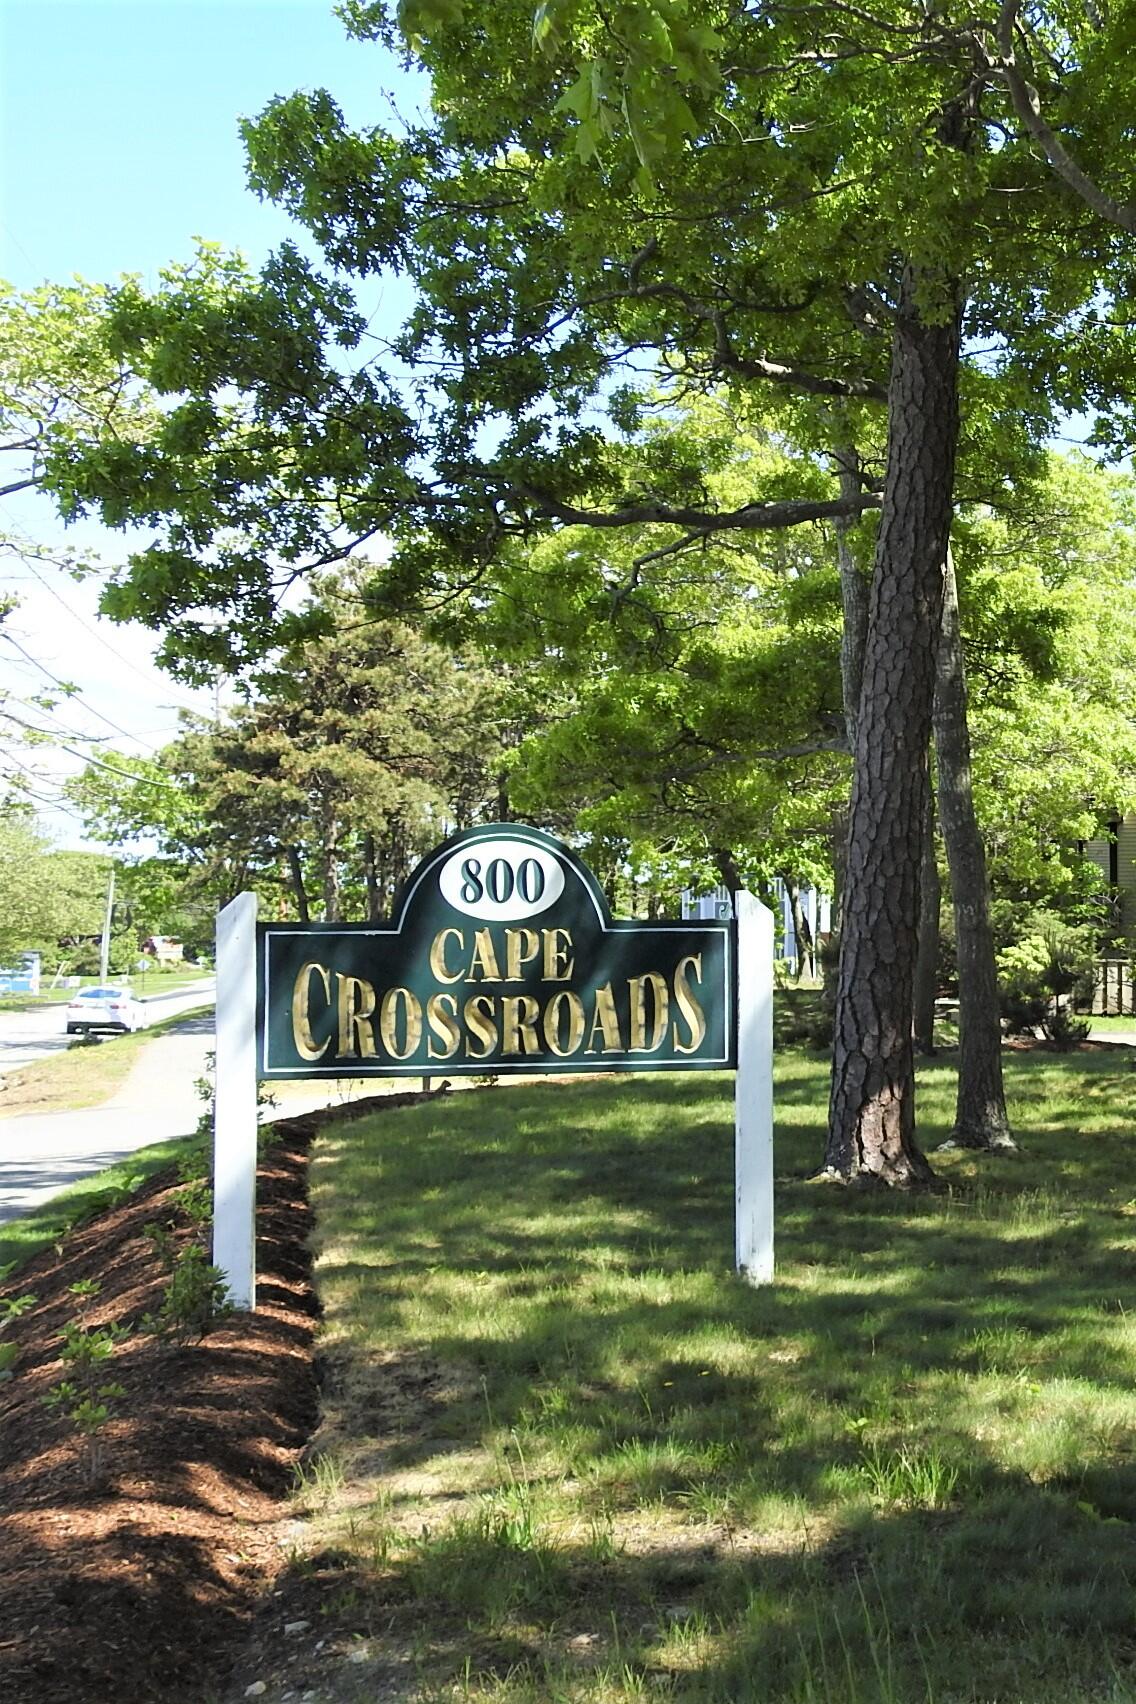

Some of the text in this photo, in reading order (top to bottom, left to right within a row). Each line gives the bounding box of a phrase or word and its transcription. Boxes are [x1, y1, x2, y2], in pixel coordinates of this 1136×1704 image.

[460, 858, 545, 904] 800
[429, 926, 575, 985] CAPE
[292, 953, 707, 1061] CROSSROADS
